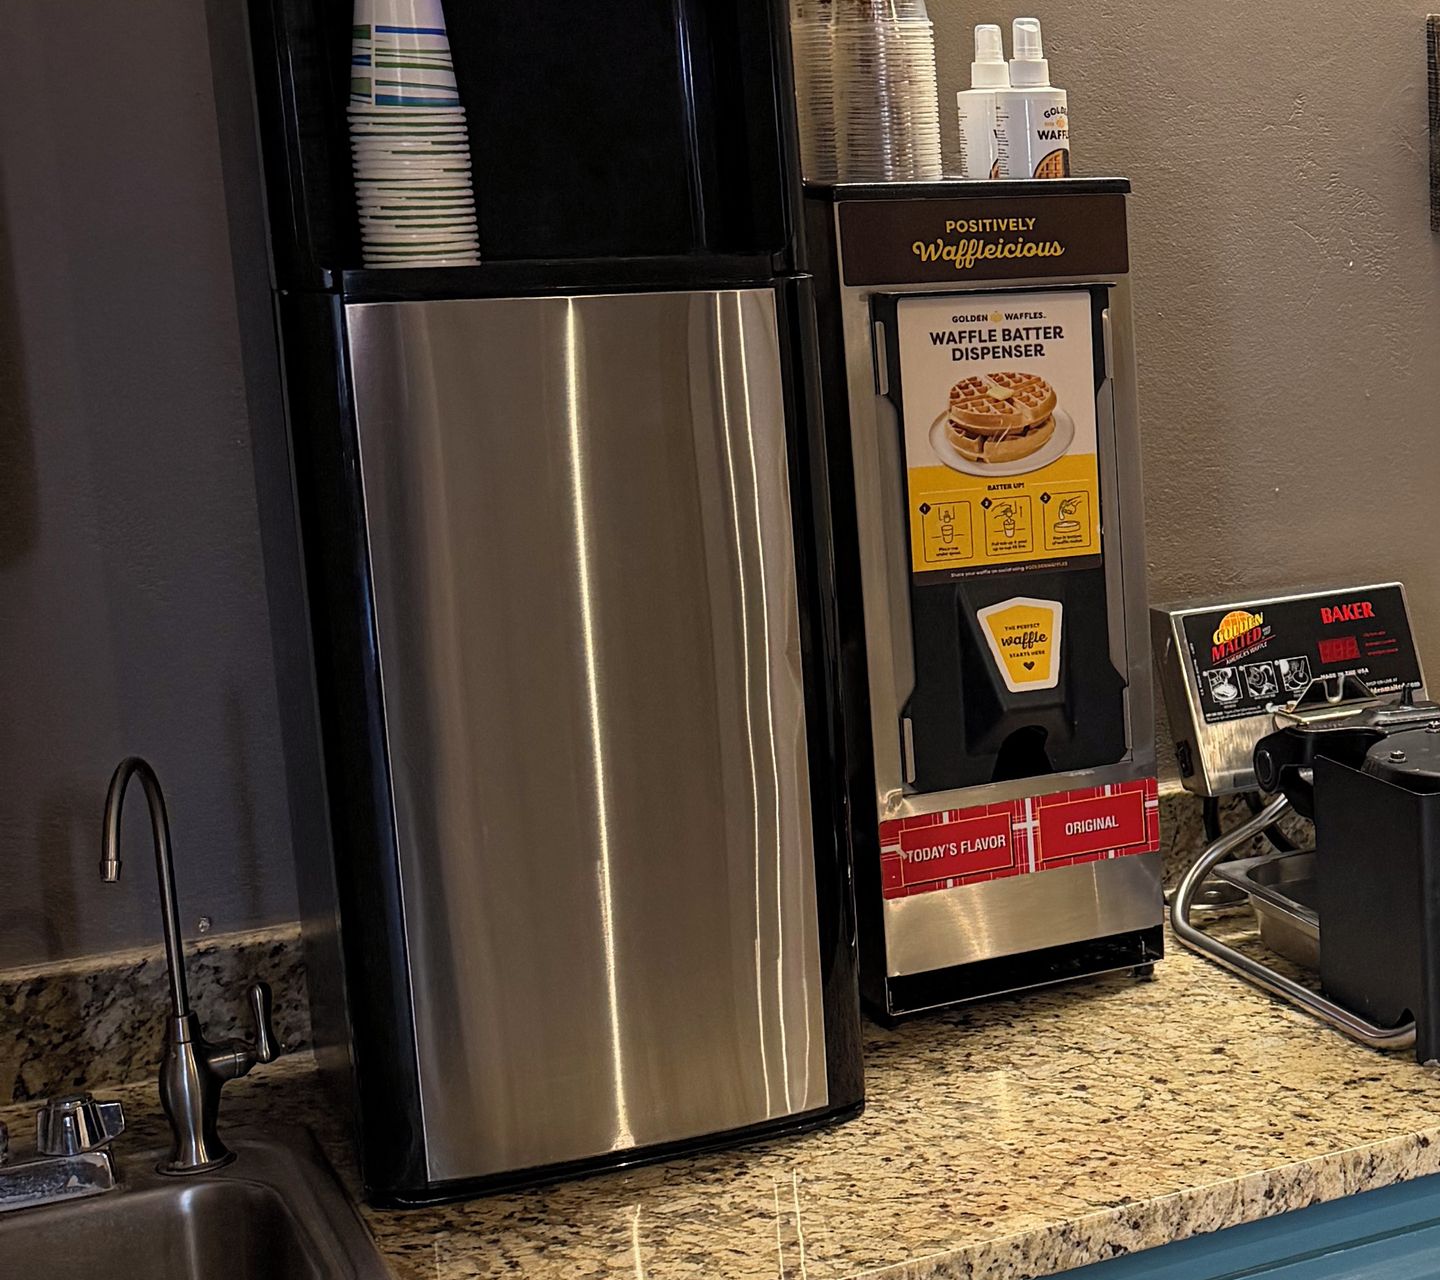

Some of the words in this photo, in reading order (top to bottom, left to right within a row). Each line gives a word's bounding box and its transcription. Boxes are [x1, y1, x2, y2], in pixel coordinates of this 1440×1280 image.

[945, 217, 1036, 233] POSITIVELY
[912, 236, 1065, 269] Waffleicious
[951, 314, 988, 323] GOLDEN
[929, 329, 997, 346] WAFFLE
[1001, 326, 1064, 342] BATTER
[951, 344, 1045, 361] DISPENSER
[1320, 601, 1376, 625] BAKER
[1016, 622, 1040, 630] PERFECT
[1212, 611, 1263, 645] GOLDEN
[1001, 631, 1048, 650] waffle
[1211, 626, 1263, 662] MALTED
[1065, 815, 1119, 835] ORIGINAL
[906, 842, 958, 863] TODAY'S
[960, 834, 1007, 854] FLAVOR
